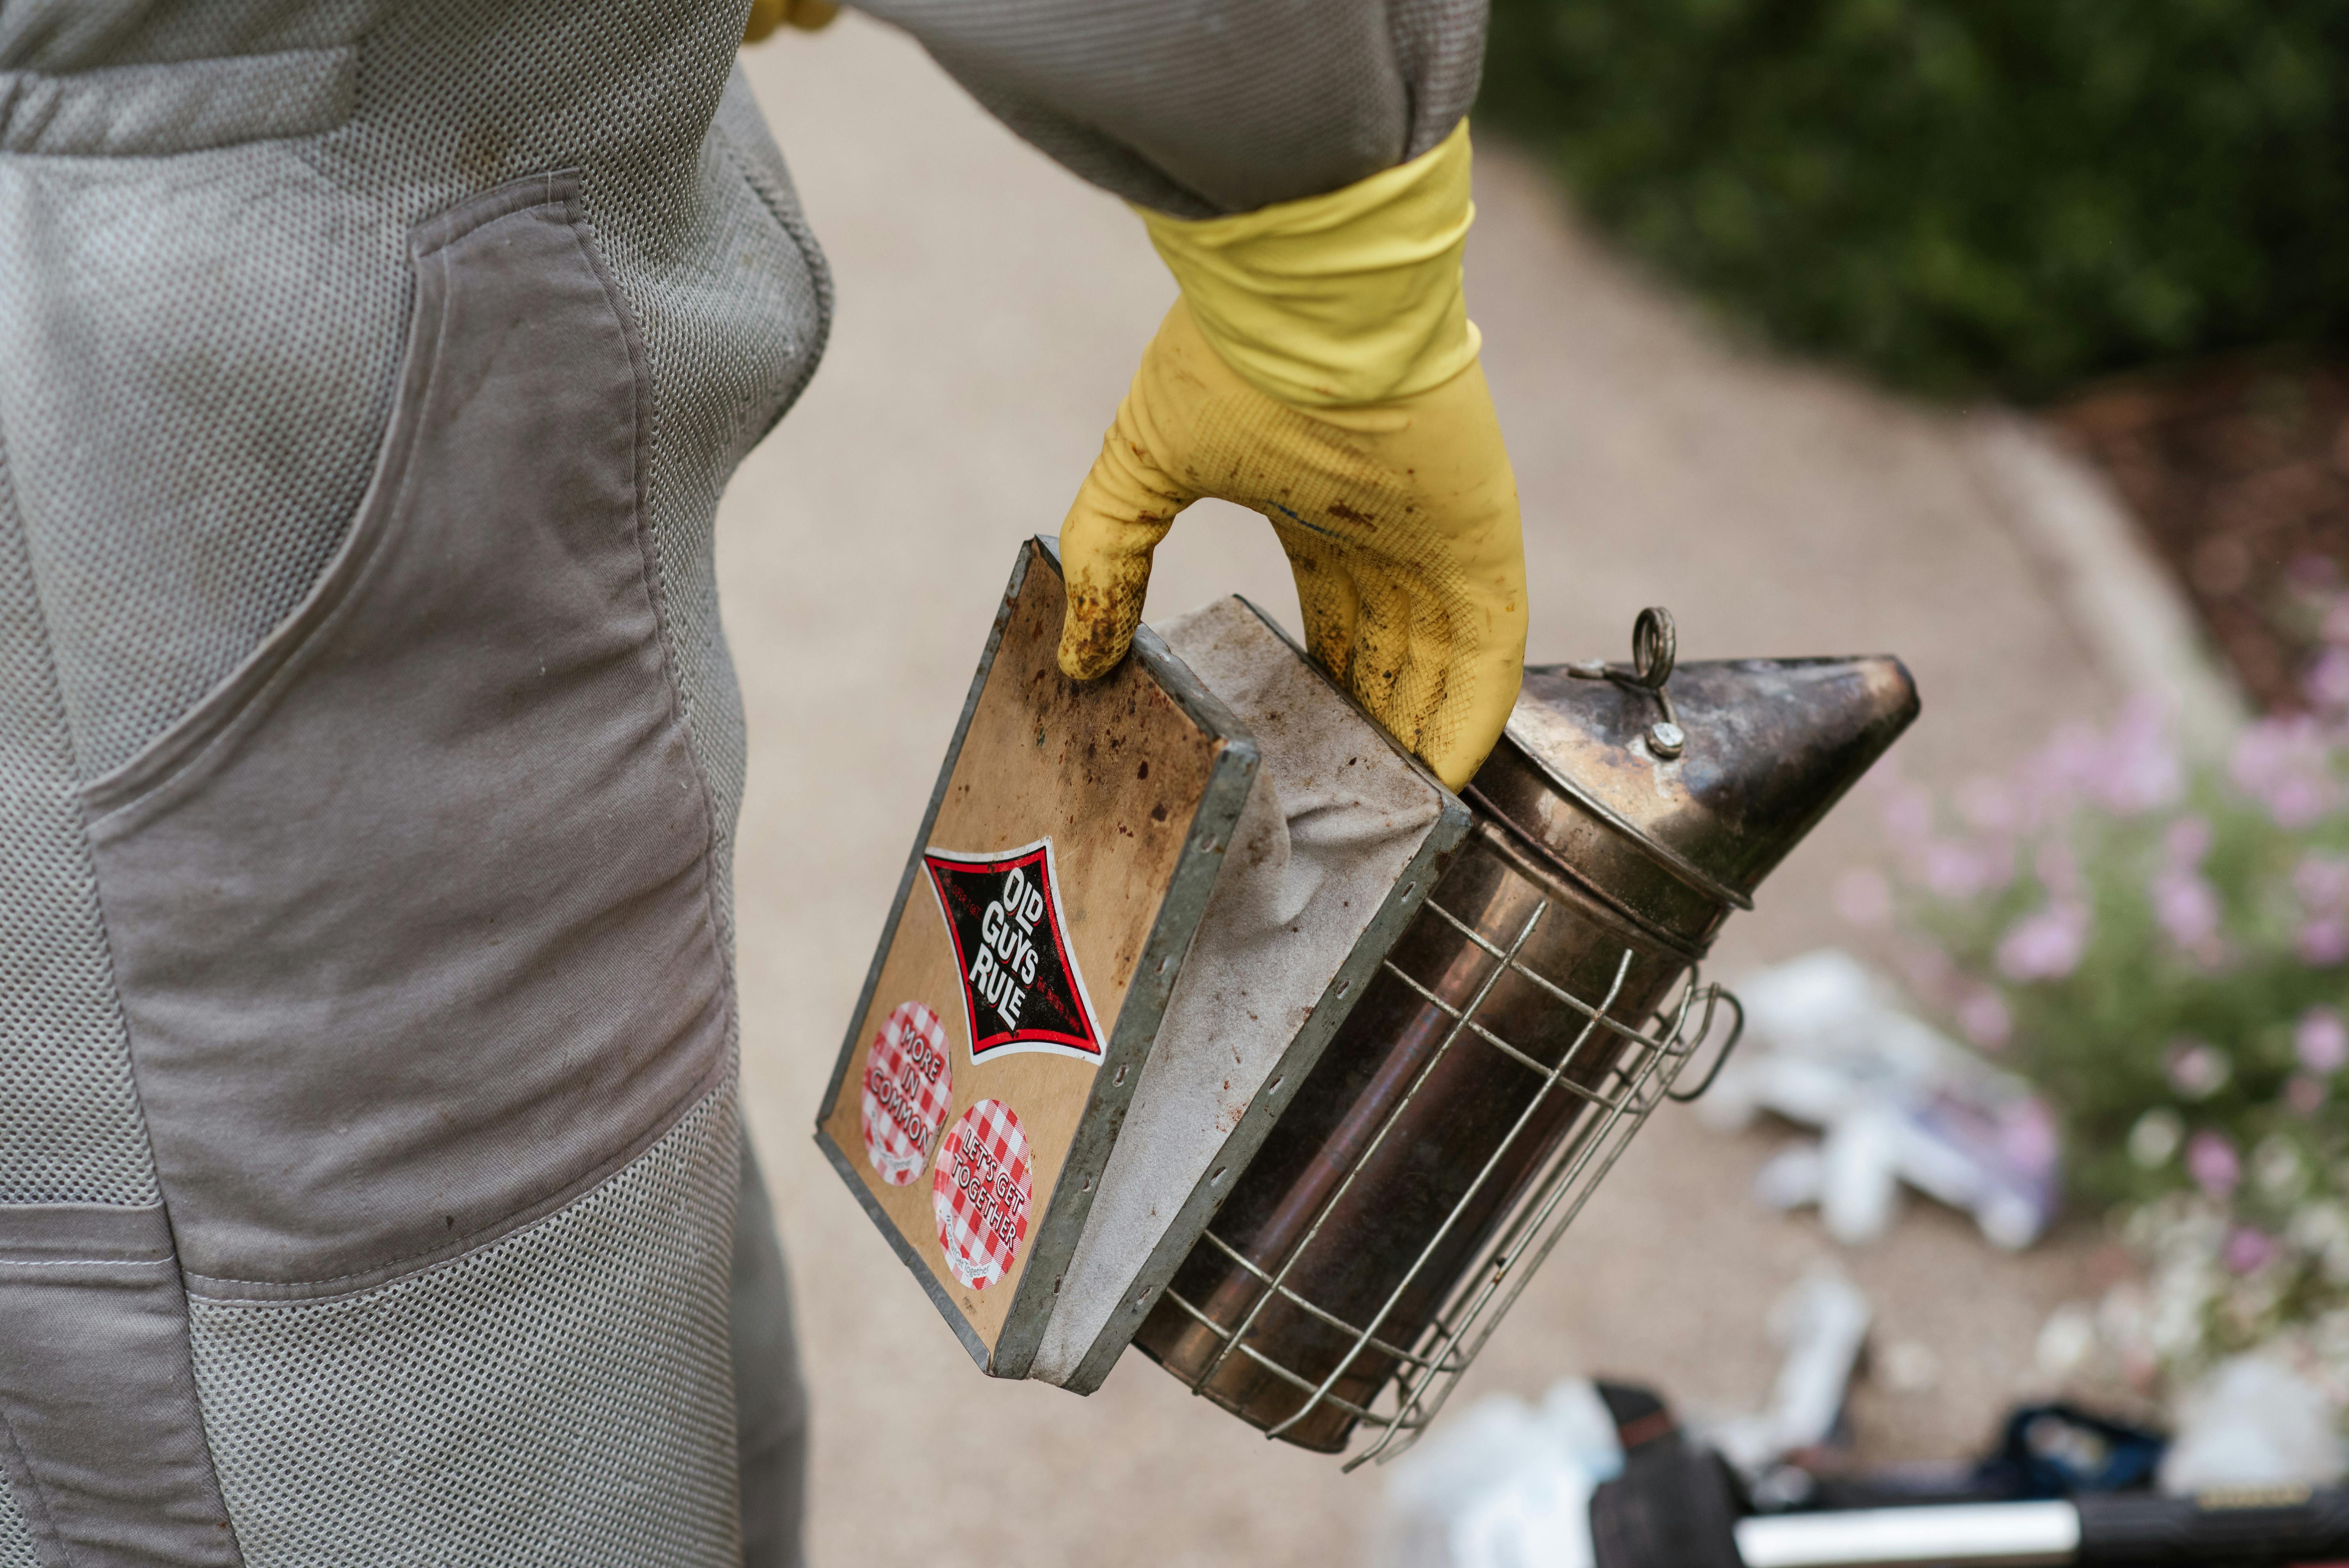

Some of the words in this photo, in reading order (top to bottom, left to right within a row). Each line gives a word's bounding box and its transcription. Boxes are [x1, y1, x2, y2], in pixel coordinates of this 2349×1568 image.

[982, 900, 1039, 985] GUYS
[1003, 867, 1043, 936] OLD
[968, 943, 1026, 1031] RULE
[900, 1023, 941, 1084] MORE
[901, 1064, 920, 1099] IN
[871, 1068, 933, 1156] COMMON
[952, 1152, 1016, 1253] TOGETHER
[962, 1130, 996, 1183] LET'S
[996, 1172, 1025, 1215] GET
[946, 1215, 990, 1278] #GreatGetTogether
